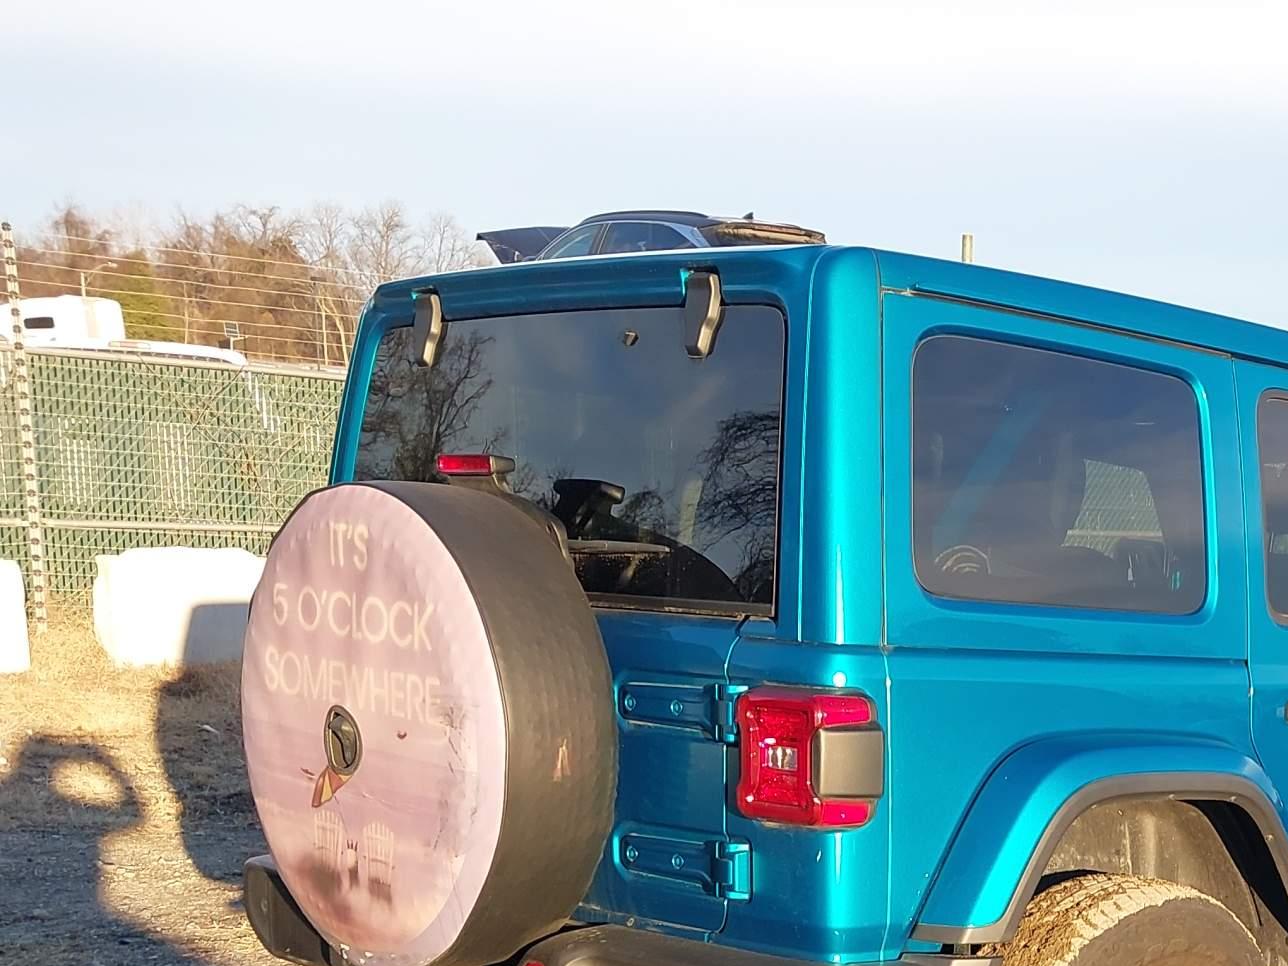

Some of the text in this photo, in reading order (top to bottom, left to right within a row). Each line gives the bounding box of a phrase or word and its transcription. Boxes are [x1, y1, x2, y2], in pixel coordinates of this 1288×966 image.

[328, 520, 369, 571] IT'S
[272, 582, 435, 652] 5 O'CLOCK
[264, 644, 441, 725] SOMEWHERE
